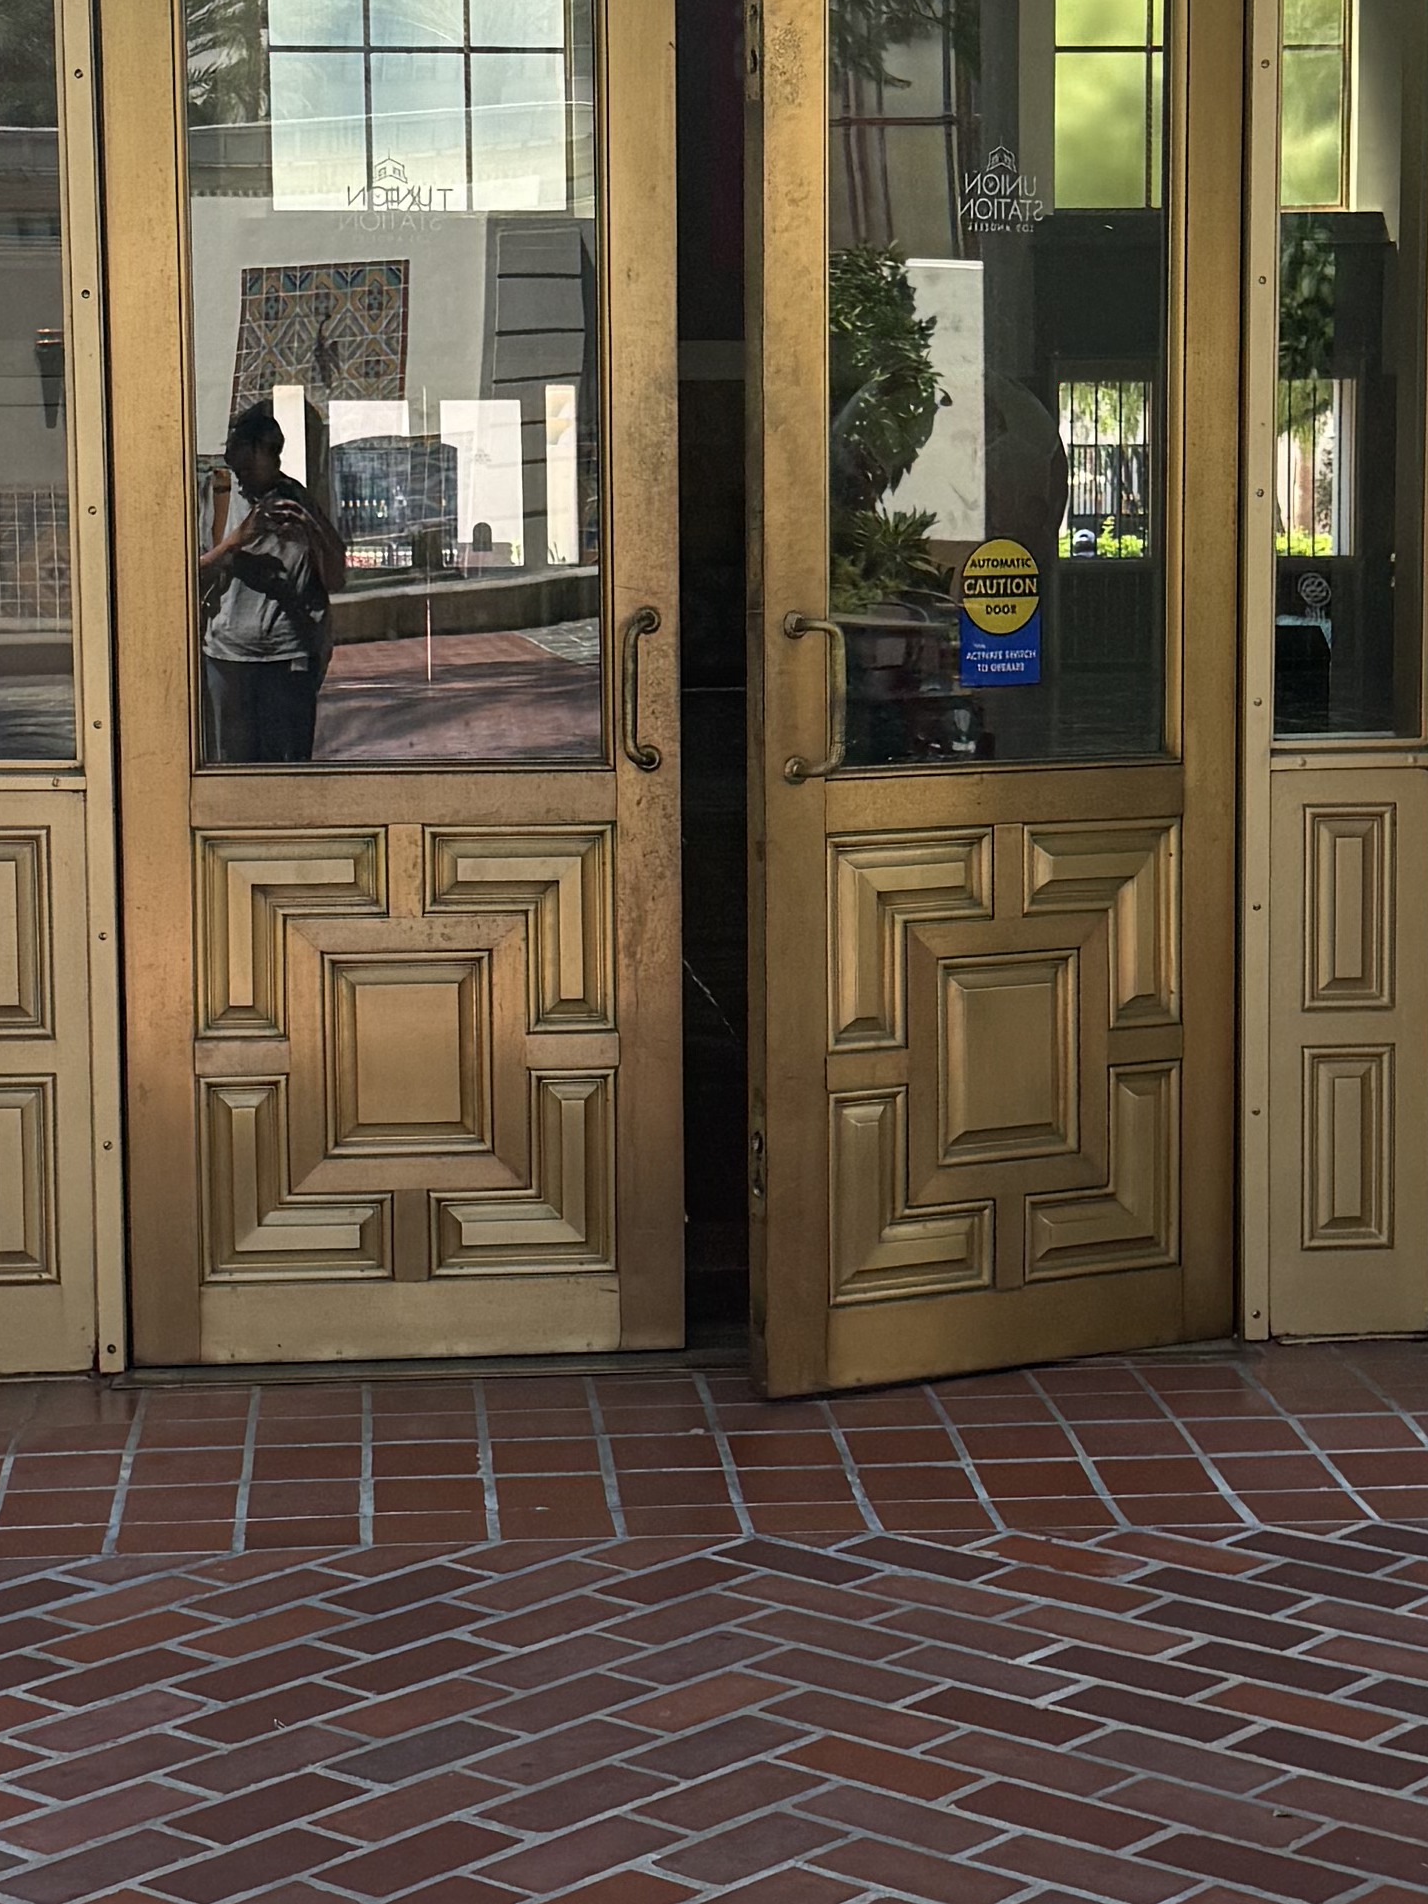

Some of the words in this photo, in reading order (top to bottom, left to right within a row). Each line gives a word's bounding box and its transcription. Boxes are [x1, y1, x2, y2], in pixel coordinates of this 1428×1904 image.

[970, 557, 1032, 569] AUTOMATIC
[964, 578, 1037, 595] CAUTION
[985, 604, 1017, 615] DOOR
